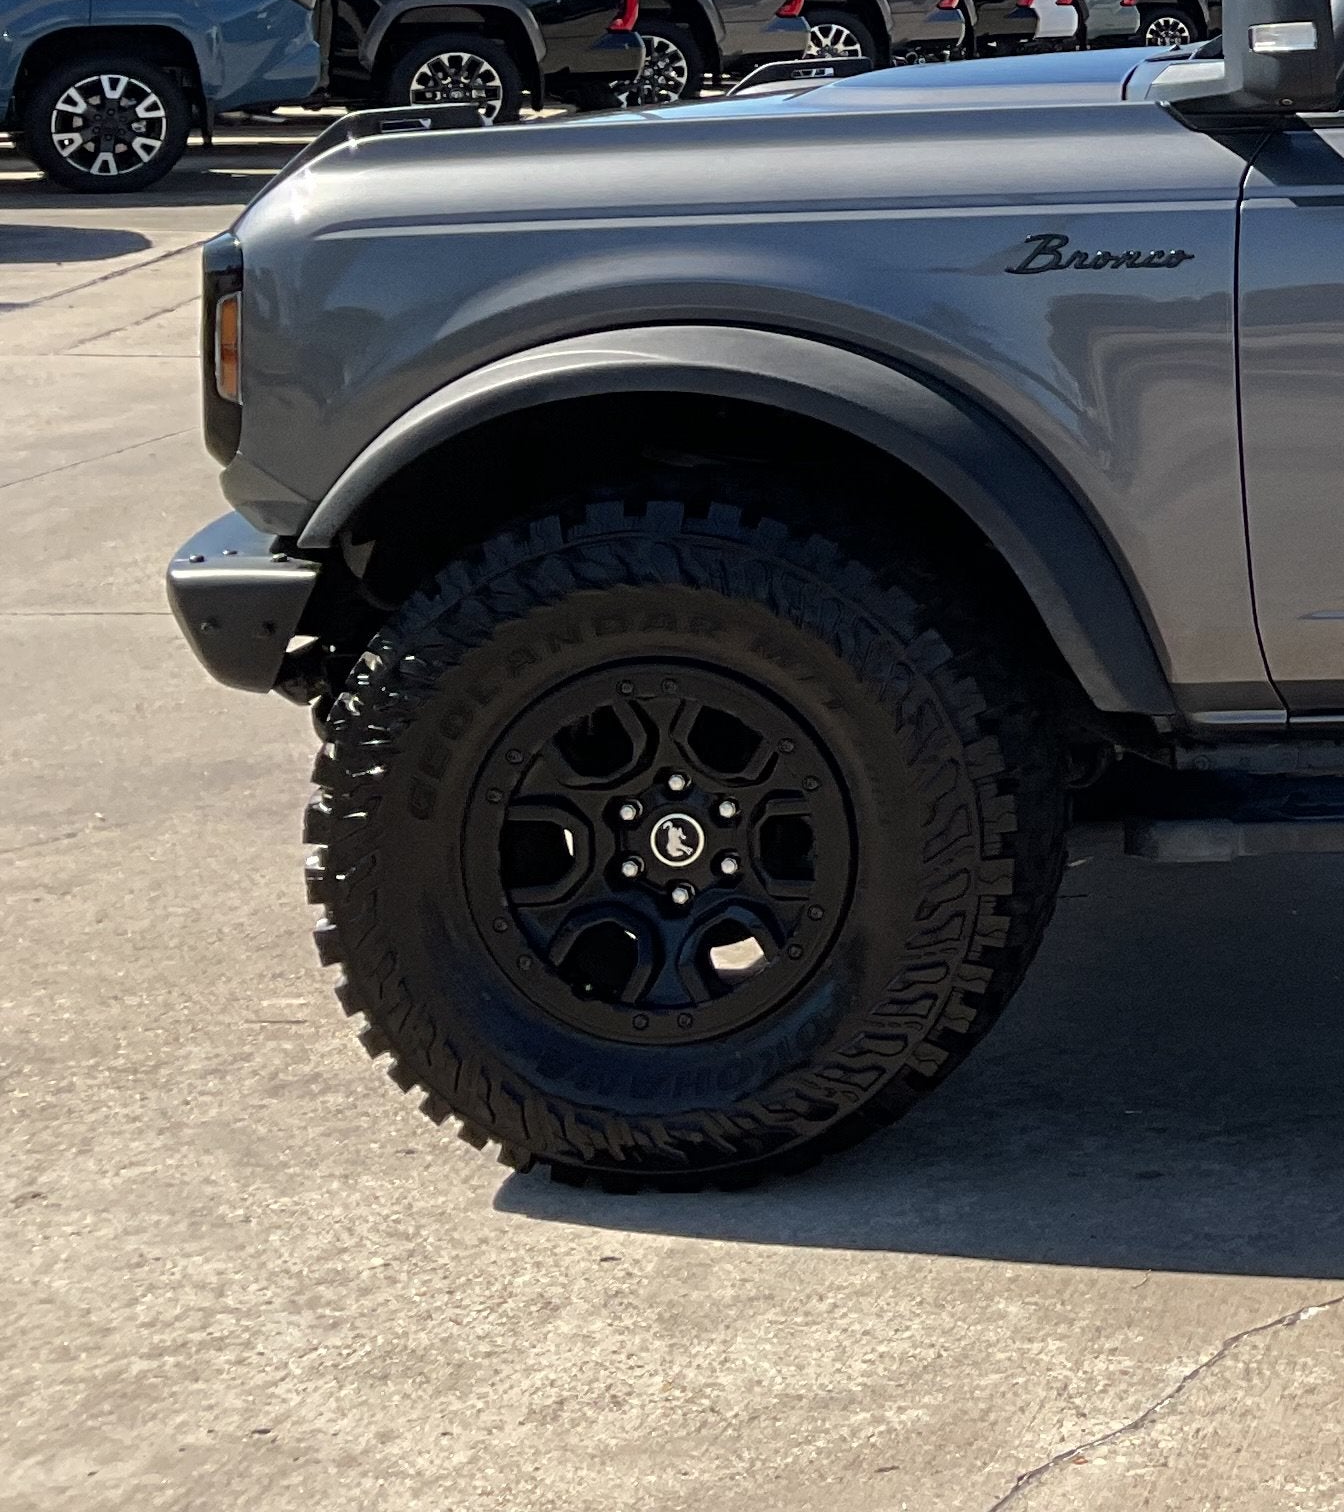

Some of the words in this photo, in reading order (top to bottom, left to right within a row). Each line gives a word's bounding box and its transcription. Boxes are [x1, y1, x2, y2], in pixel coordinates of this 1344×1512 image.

[1004, 233, 1195, 275] Bronco
[408, 608, 725, 822] GEOLANDAR
[747, 630, 848, 712] M/T
